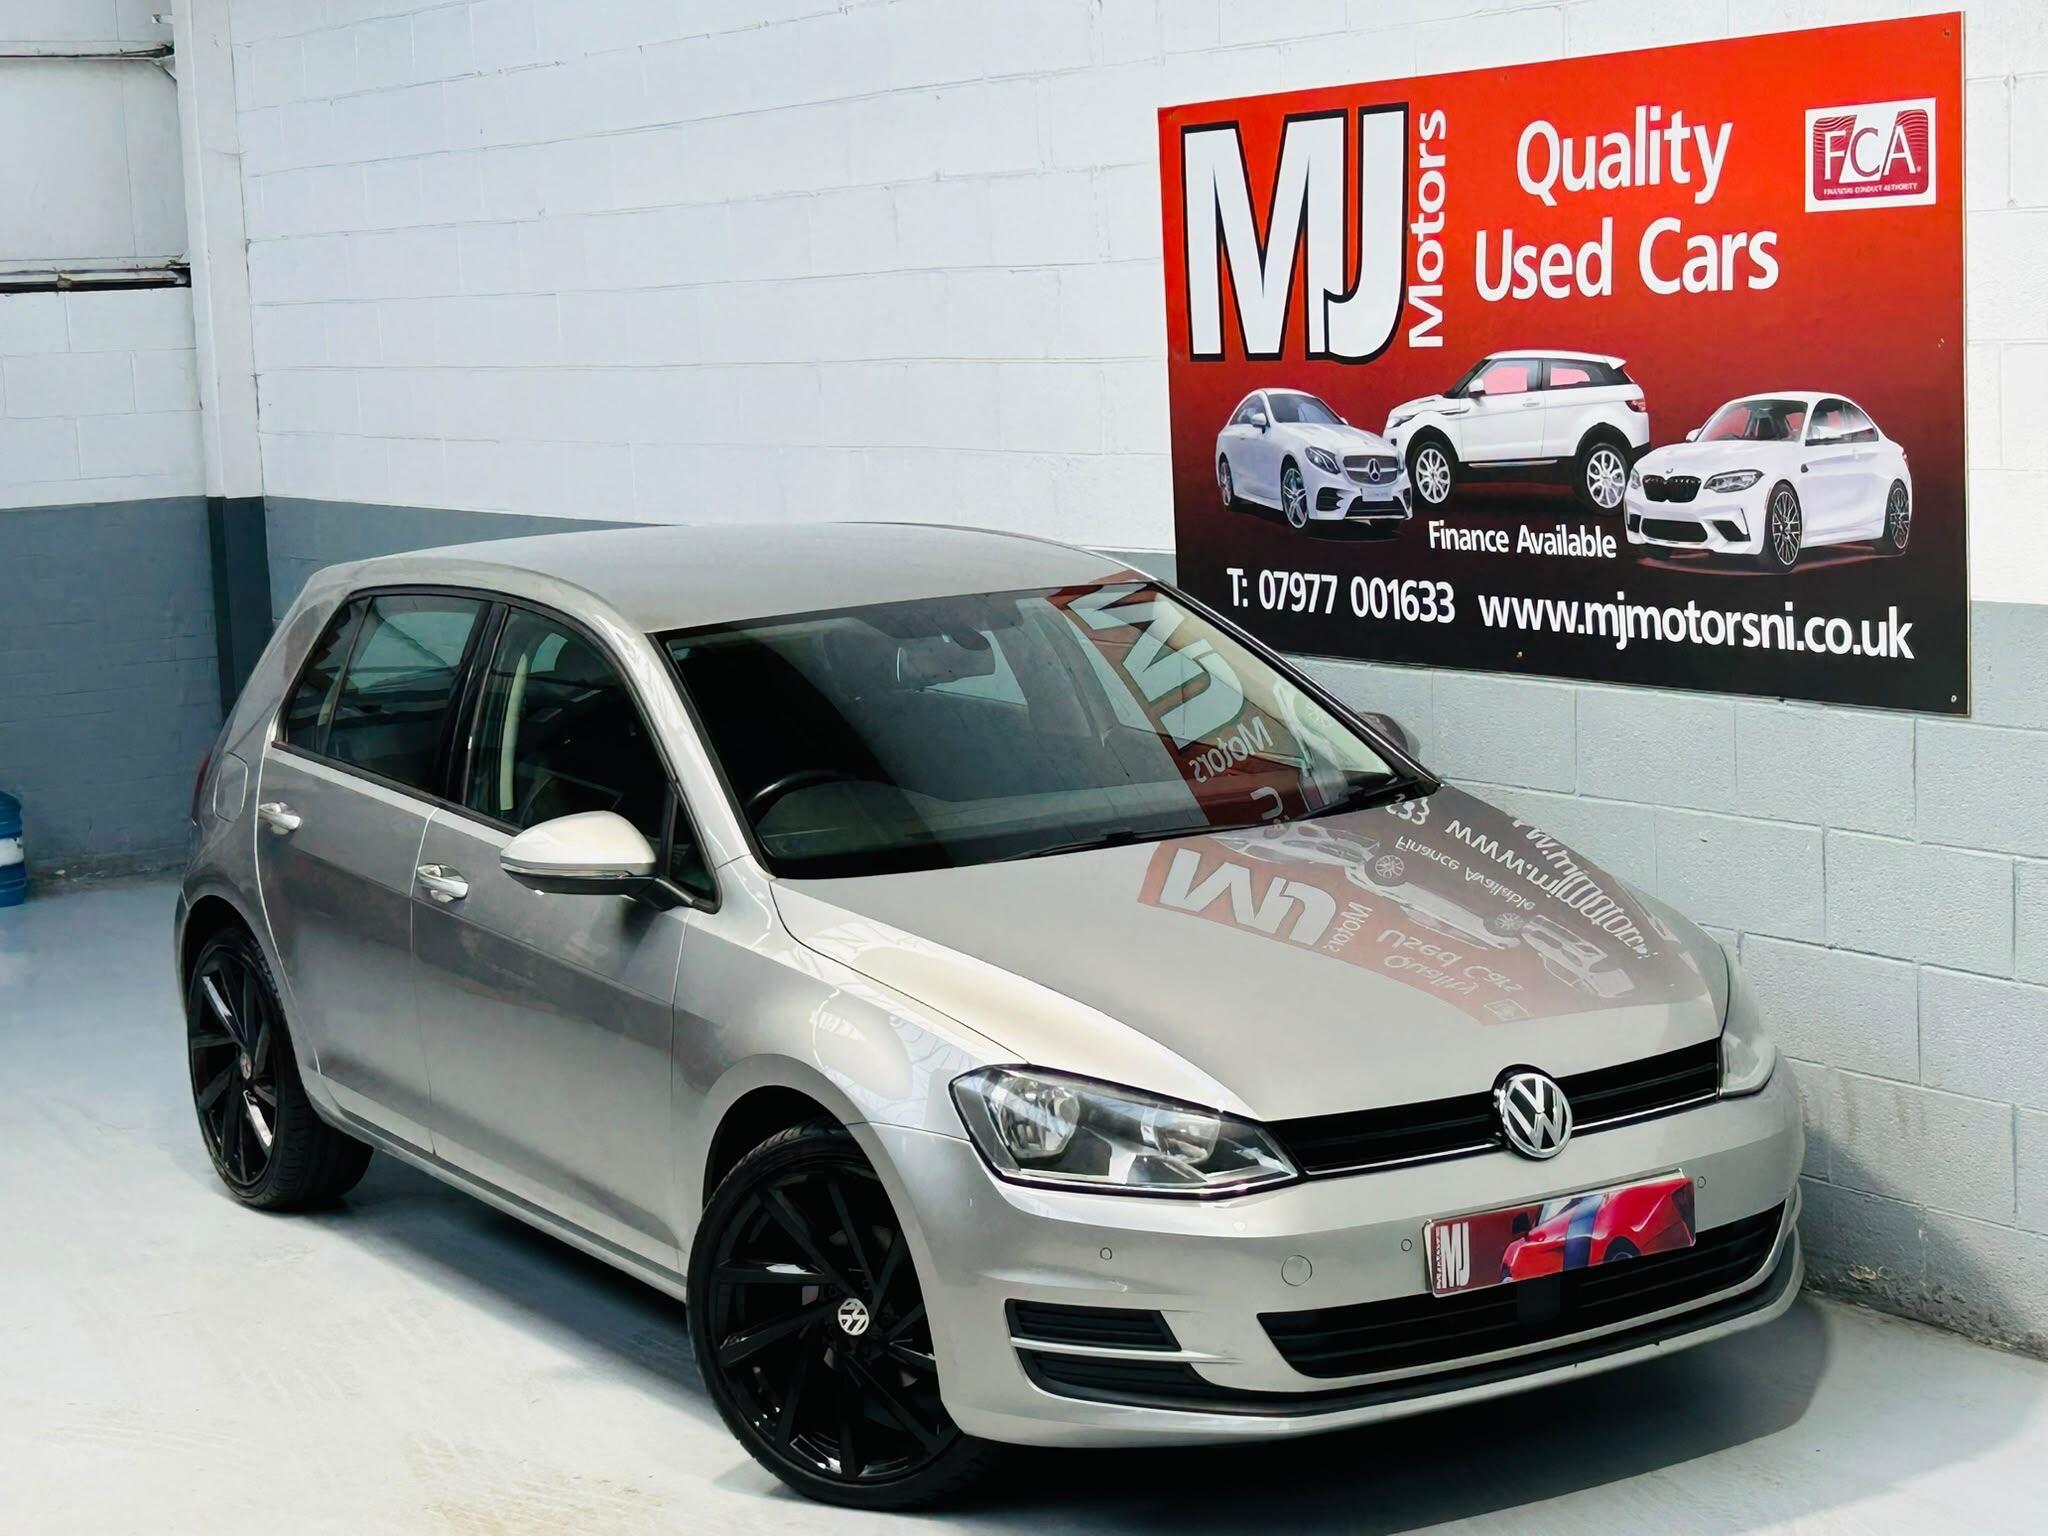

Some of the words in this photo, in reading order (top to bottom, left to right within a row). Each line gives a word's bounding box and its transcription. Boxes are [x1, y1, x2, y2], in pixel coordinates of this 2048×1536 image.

[1516, 105, 1733, 207] Quality
[1824, 124, 1917, 180] FCA
[1183, 102, 1409, 364] MJ
[1408, 109, 1447, 348] Motors
[1475, 216, 1612, 301] Used
[1639, 217, 1779, 295] Cars
[1428, 519, 1510, 553] Finance
[1516, 523, 1617, 559] Available
[1226, 567, 1249, 609] T:
[1258, 569, 1338, 614] 07977
[1350, 576, 1456, 624] 001633
[1477, 590, 1915, 660] www.mjmotorsni.co.uk
[1440, 1221, 1471, 1289] MJ
